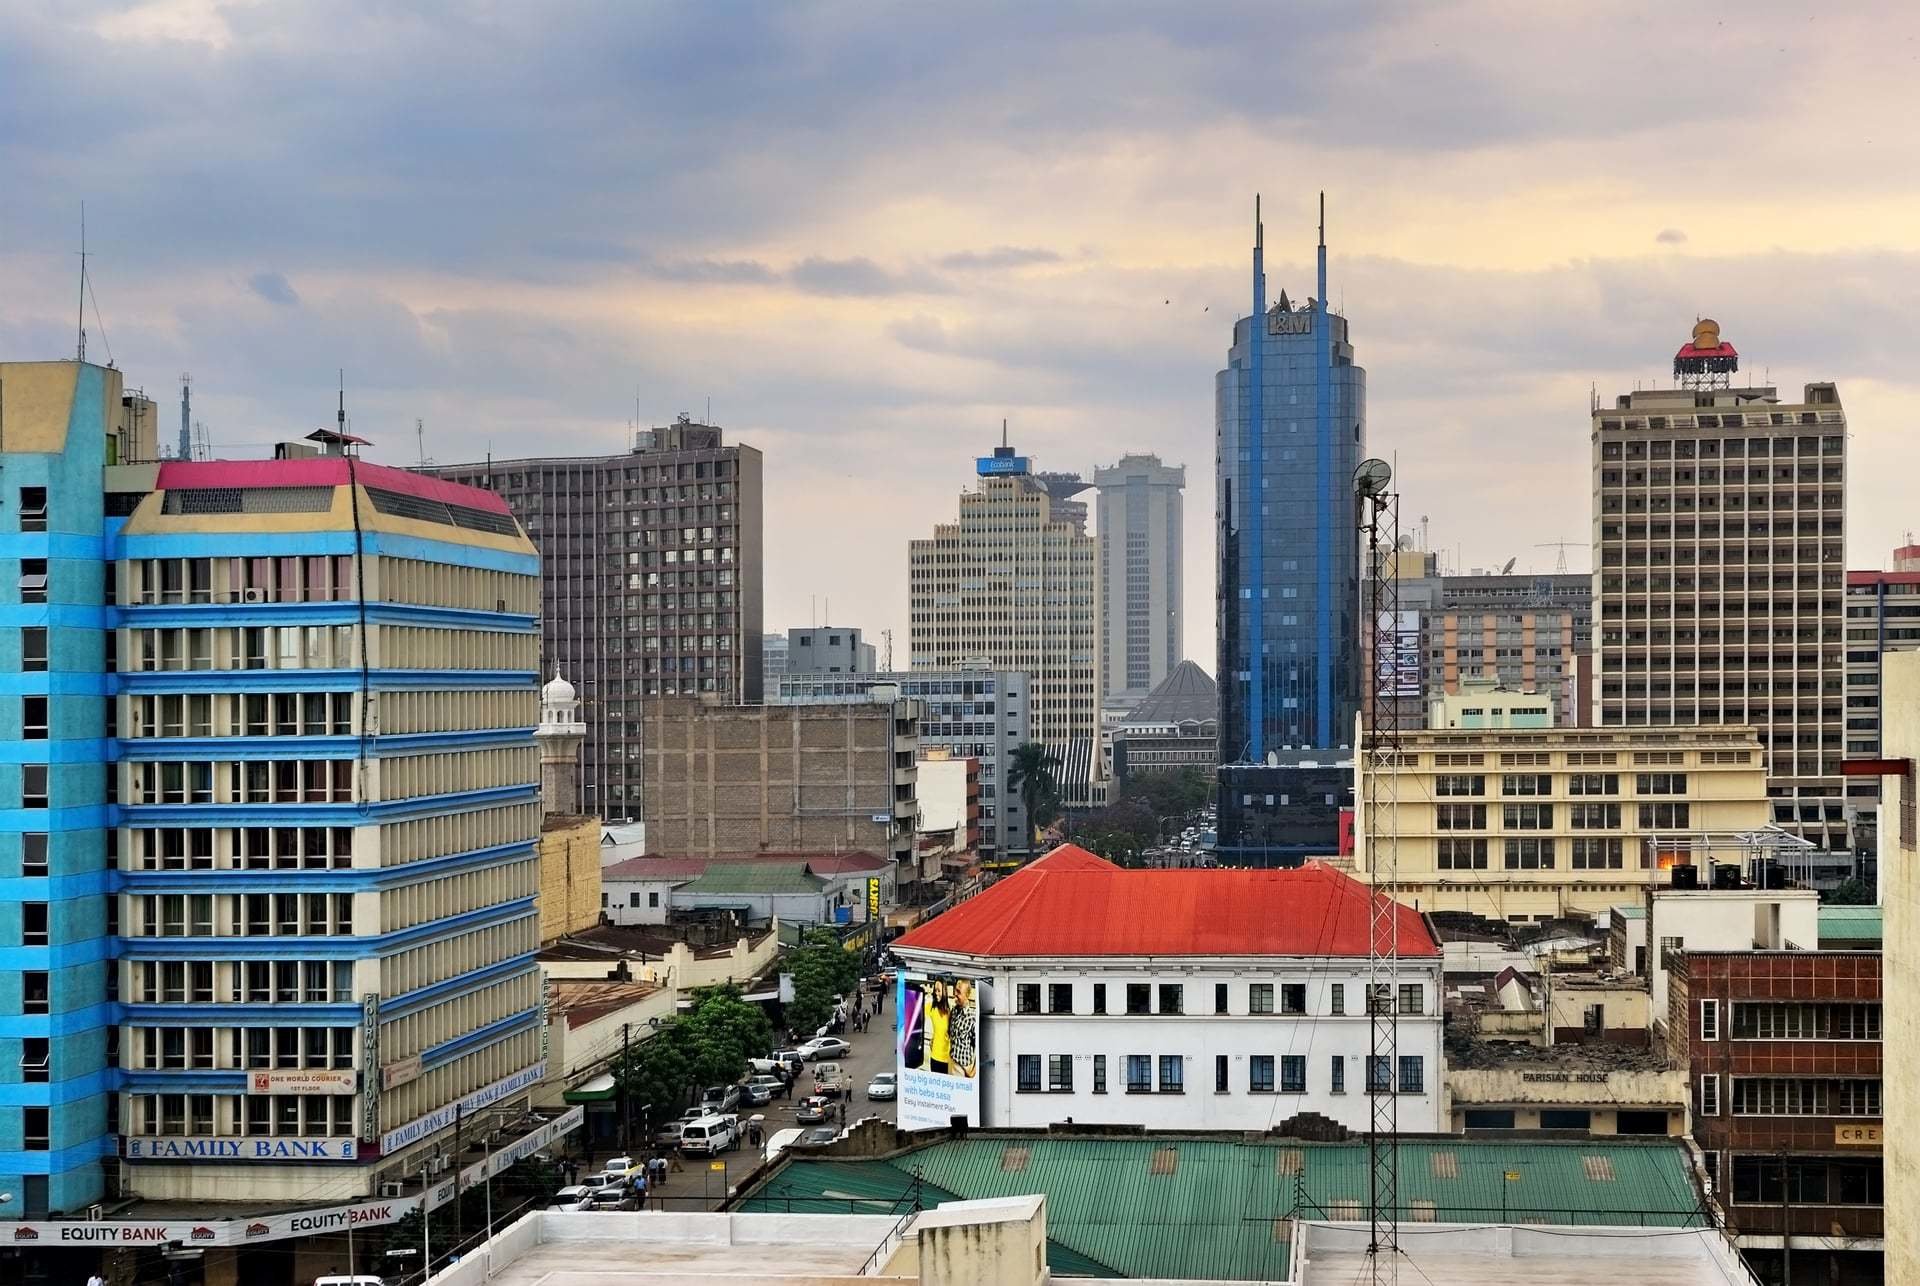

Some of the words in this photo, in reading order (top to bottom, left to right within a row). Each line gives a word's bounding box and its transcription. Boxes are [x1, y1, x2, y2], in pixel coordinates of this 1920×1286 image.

[918, 1074, 928, 1086] big
[942, 1080, 954, 1090] pay
[955, 1081, 973, 1091] small
[1523, 1073, 1568, 1082] PARISIAN
[1576, 1073, 1608, 1083] HOUSE
[364, 1079, 375, 1144] TOWERS
[394, 1123, 422, 1146] FAMILY
[424, 1114, 442, 1135] BANK
[1842, 1130, 1883, 1140] CRE
[151, 1140, 244, 1157] FAMILY
[255, 1140, 329, 1157] BANK
[438, 1183, 454, 1201] EQUIT
[291, 1213, 346, 1232] EQUITY
[350, 1206, 391, 1223] BANK
[62, 1228, 118, 1240] EQUITY
[122, 1228, 167, 1240] BANK
